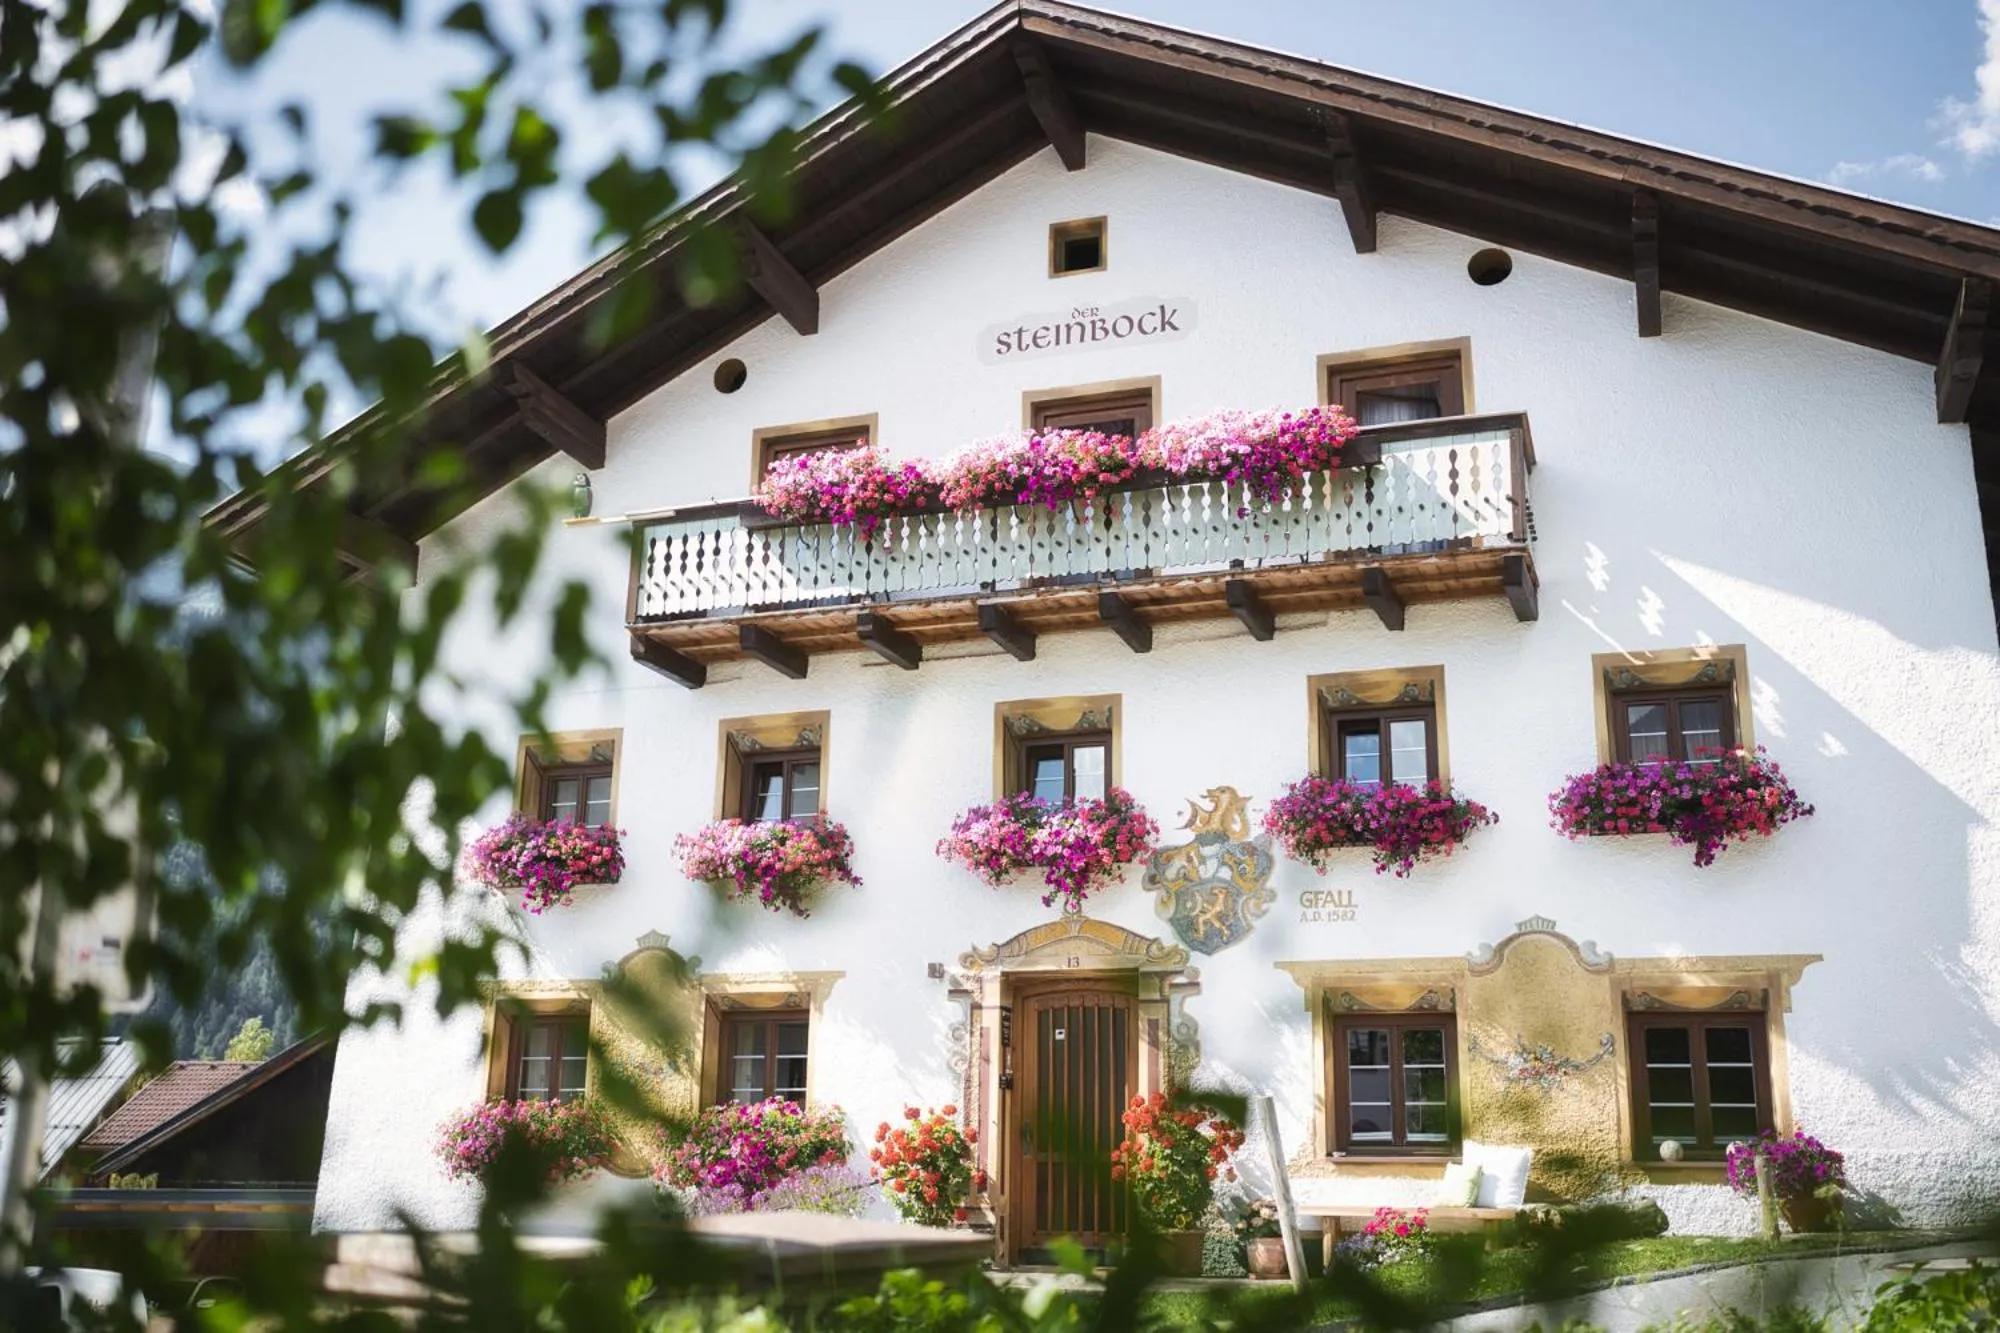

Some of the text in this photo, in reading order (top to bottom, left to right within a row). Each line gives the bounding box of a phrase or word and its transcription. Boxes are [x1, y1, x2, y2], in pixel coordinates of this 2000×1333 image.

[1071, 307, 1099, 319] DER
[1300, 890, 1358, 908] GFALL
[1067, 956, 1080, 968] 13
